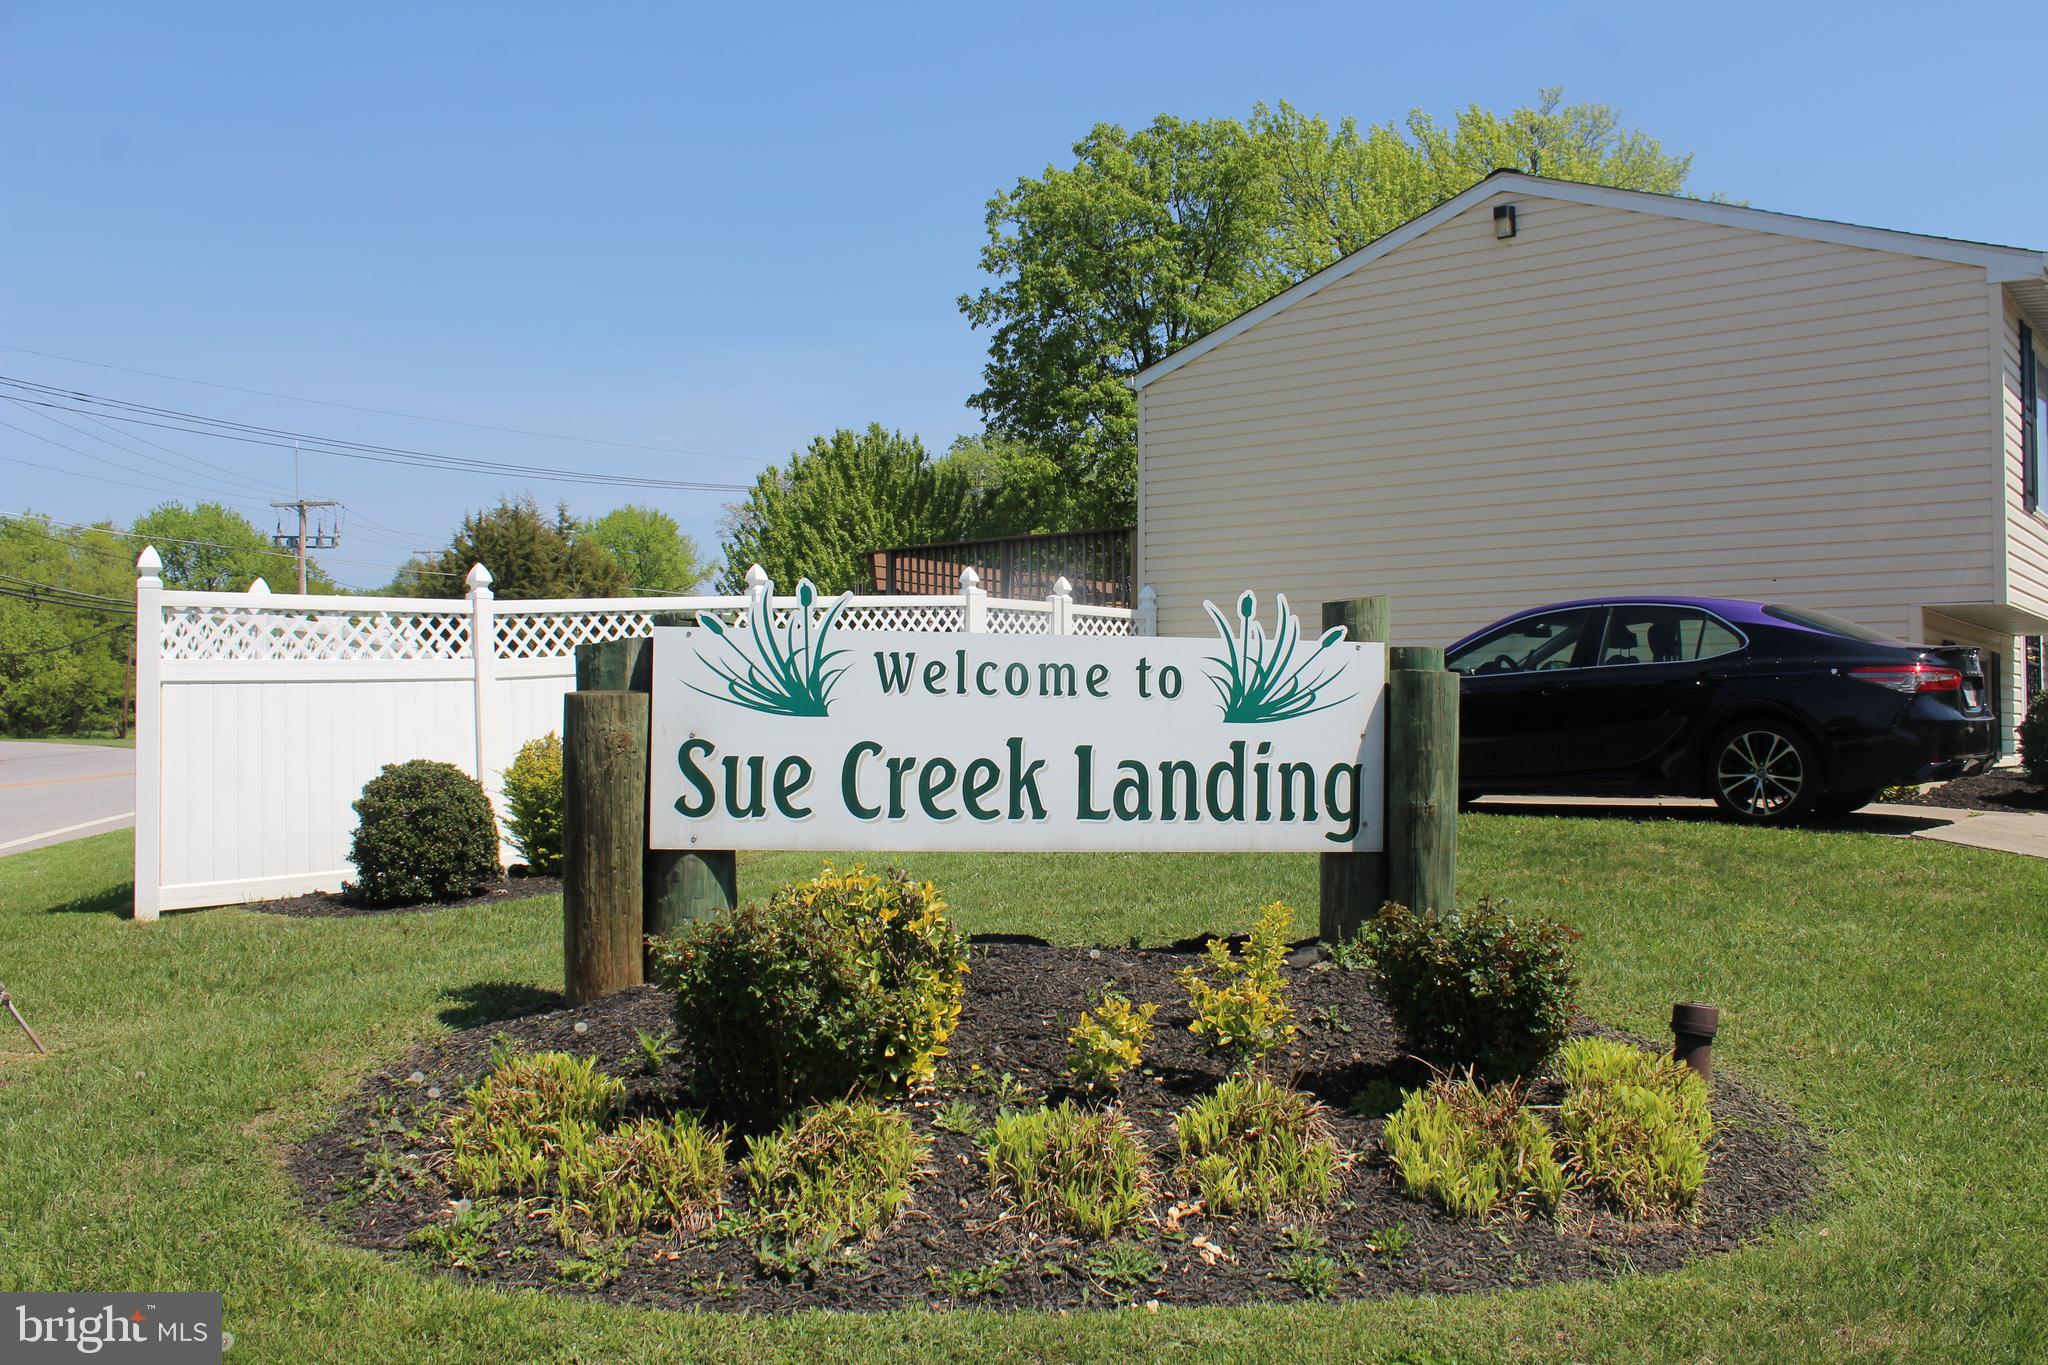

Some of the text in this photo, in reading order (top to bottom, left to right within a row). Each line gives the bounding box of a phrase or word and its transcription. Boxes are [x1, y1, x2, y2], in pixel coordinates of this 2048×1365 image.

[874, 649, 1184, 699] Welcome to
[673, 736, 1364, 843] Sue Creek Landing
